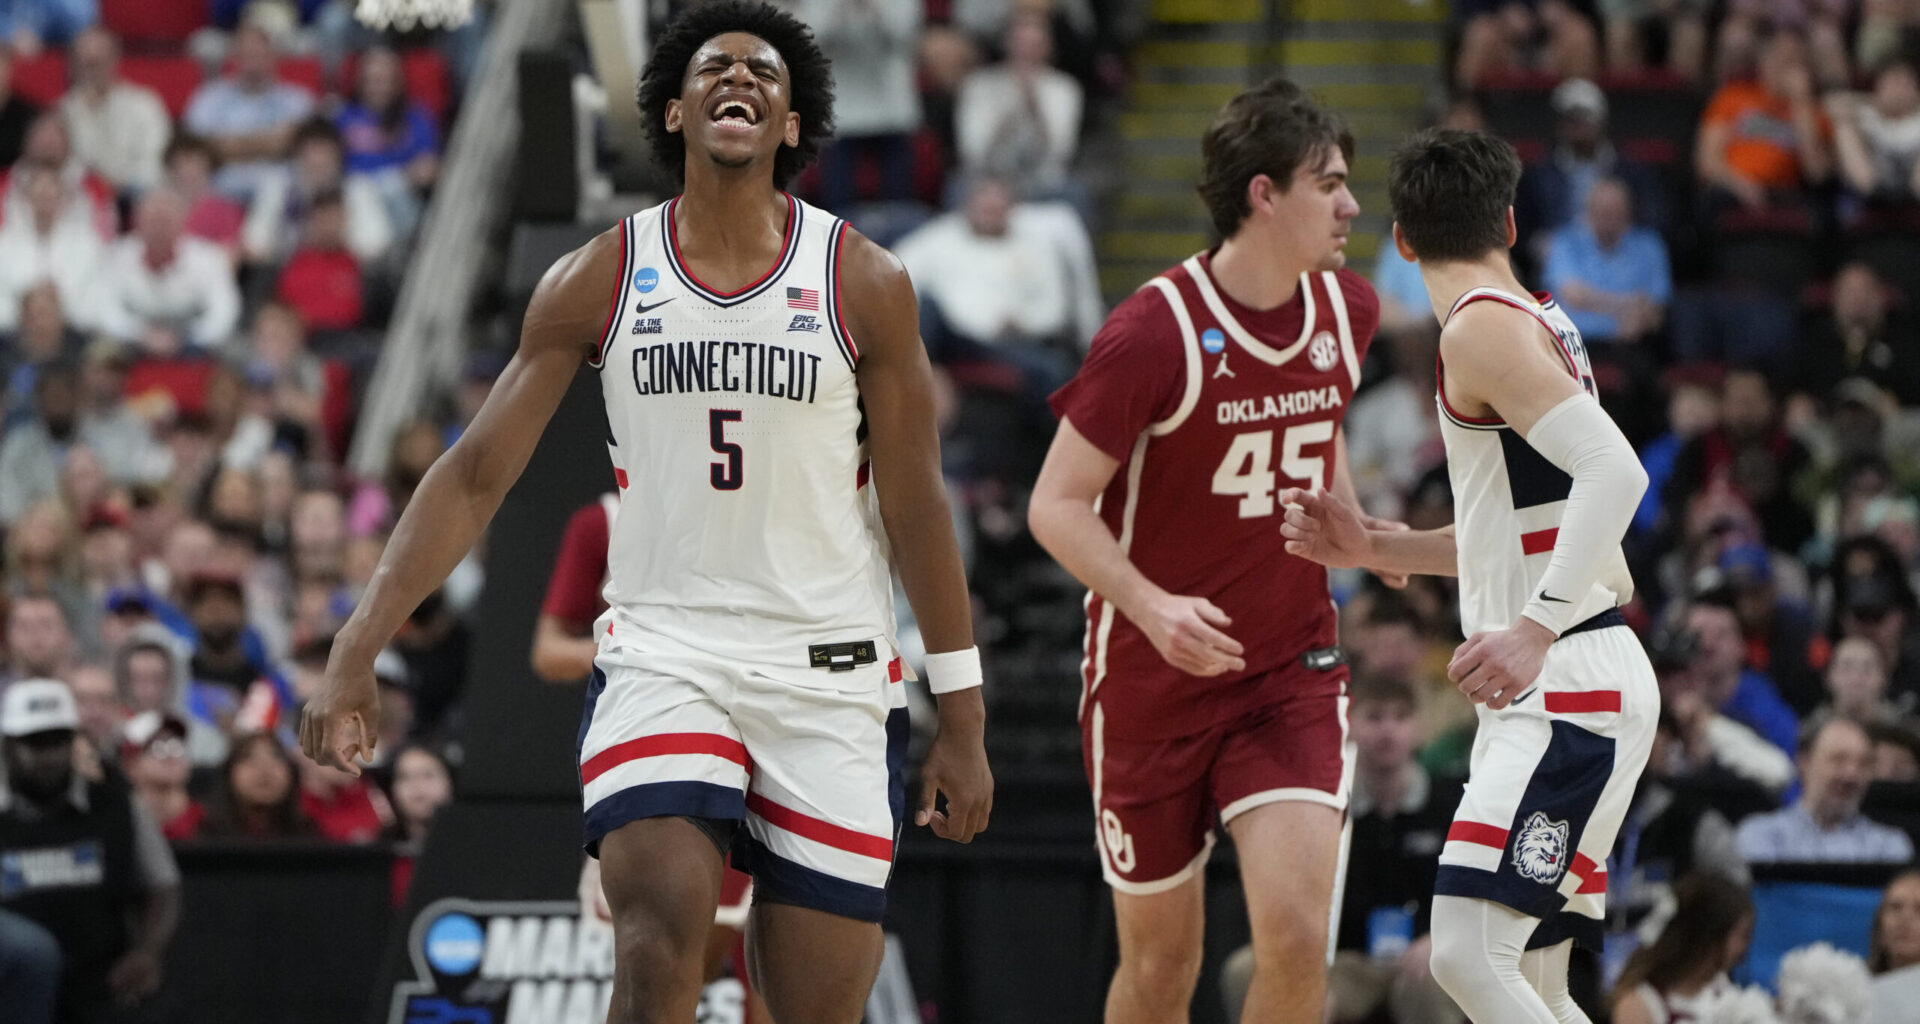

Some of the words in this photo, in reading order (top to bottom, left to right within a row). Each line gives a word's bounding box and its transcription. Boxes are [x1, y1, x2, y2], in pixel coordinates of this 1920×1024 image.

[631, 326, 663, 335] CHANGE
[635, 319, 645, 327] BE
[647, 318, 662, 327] THE
[789, 321, 823, 331] EAST
[792, 314, 817, 323] BIG
[632, 340, 822, 404] CONNECTICUT
[1216, 385, 1343, 425] OKLAHOMA
[709, 408, 744, 492] 5
[1211, 420, 1335, 519] 45
[1102, 808, 1137, 874] OU
[481, 916, 616, 978] MAR
